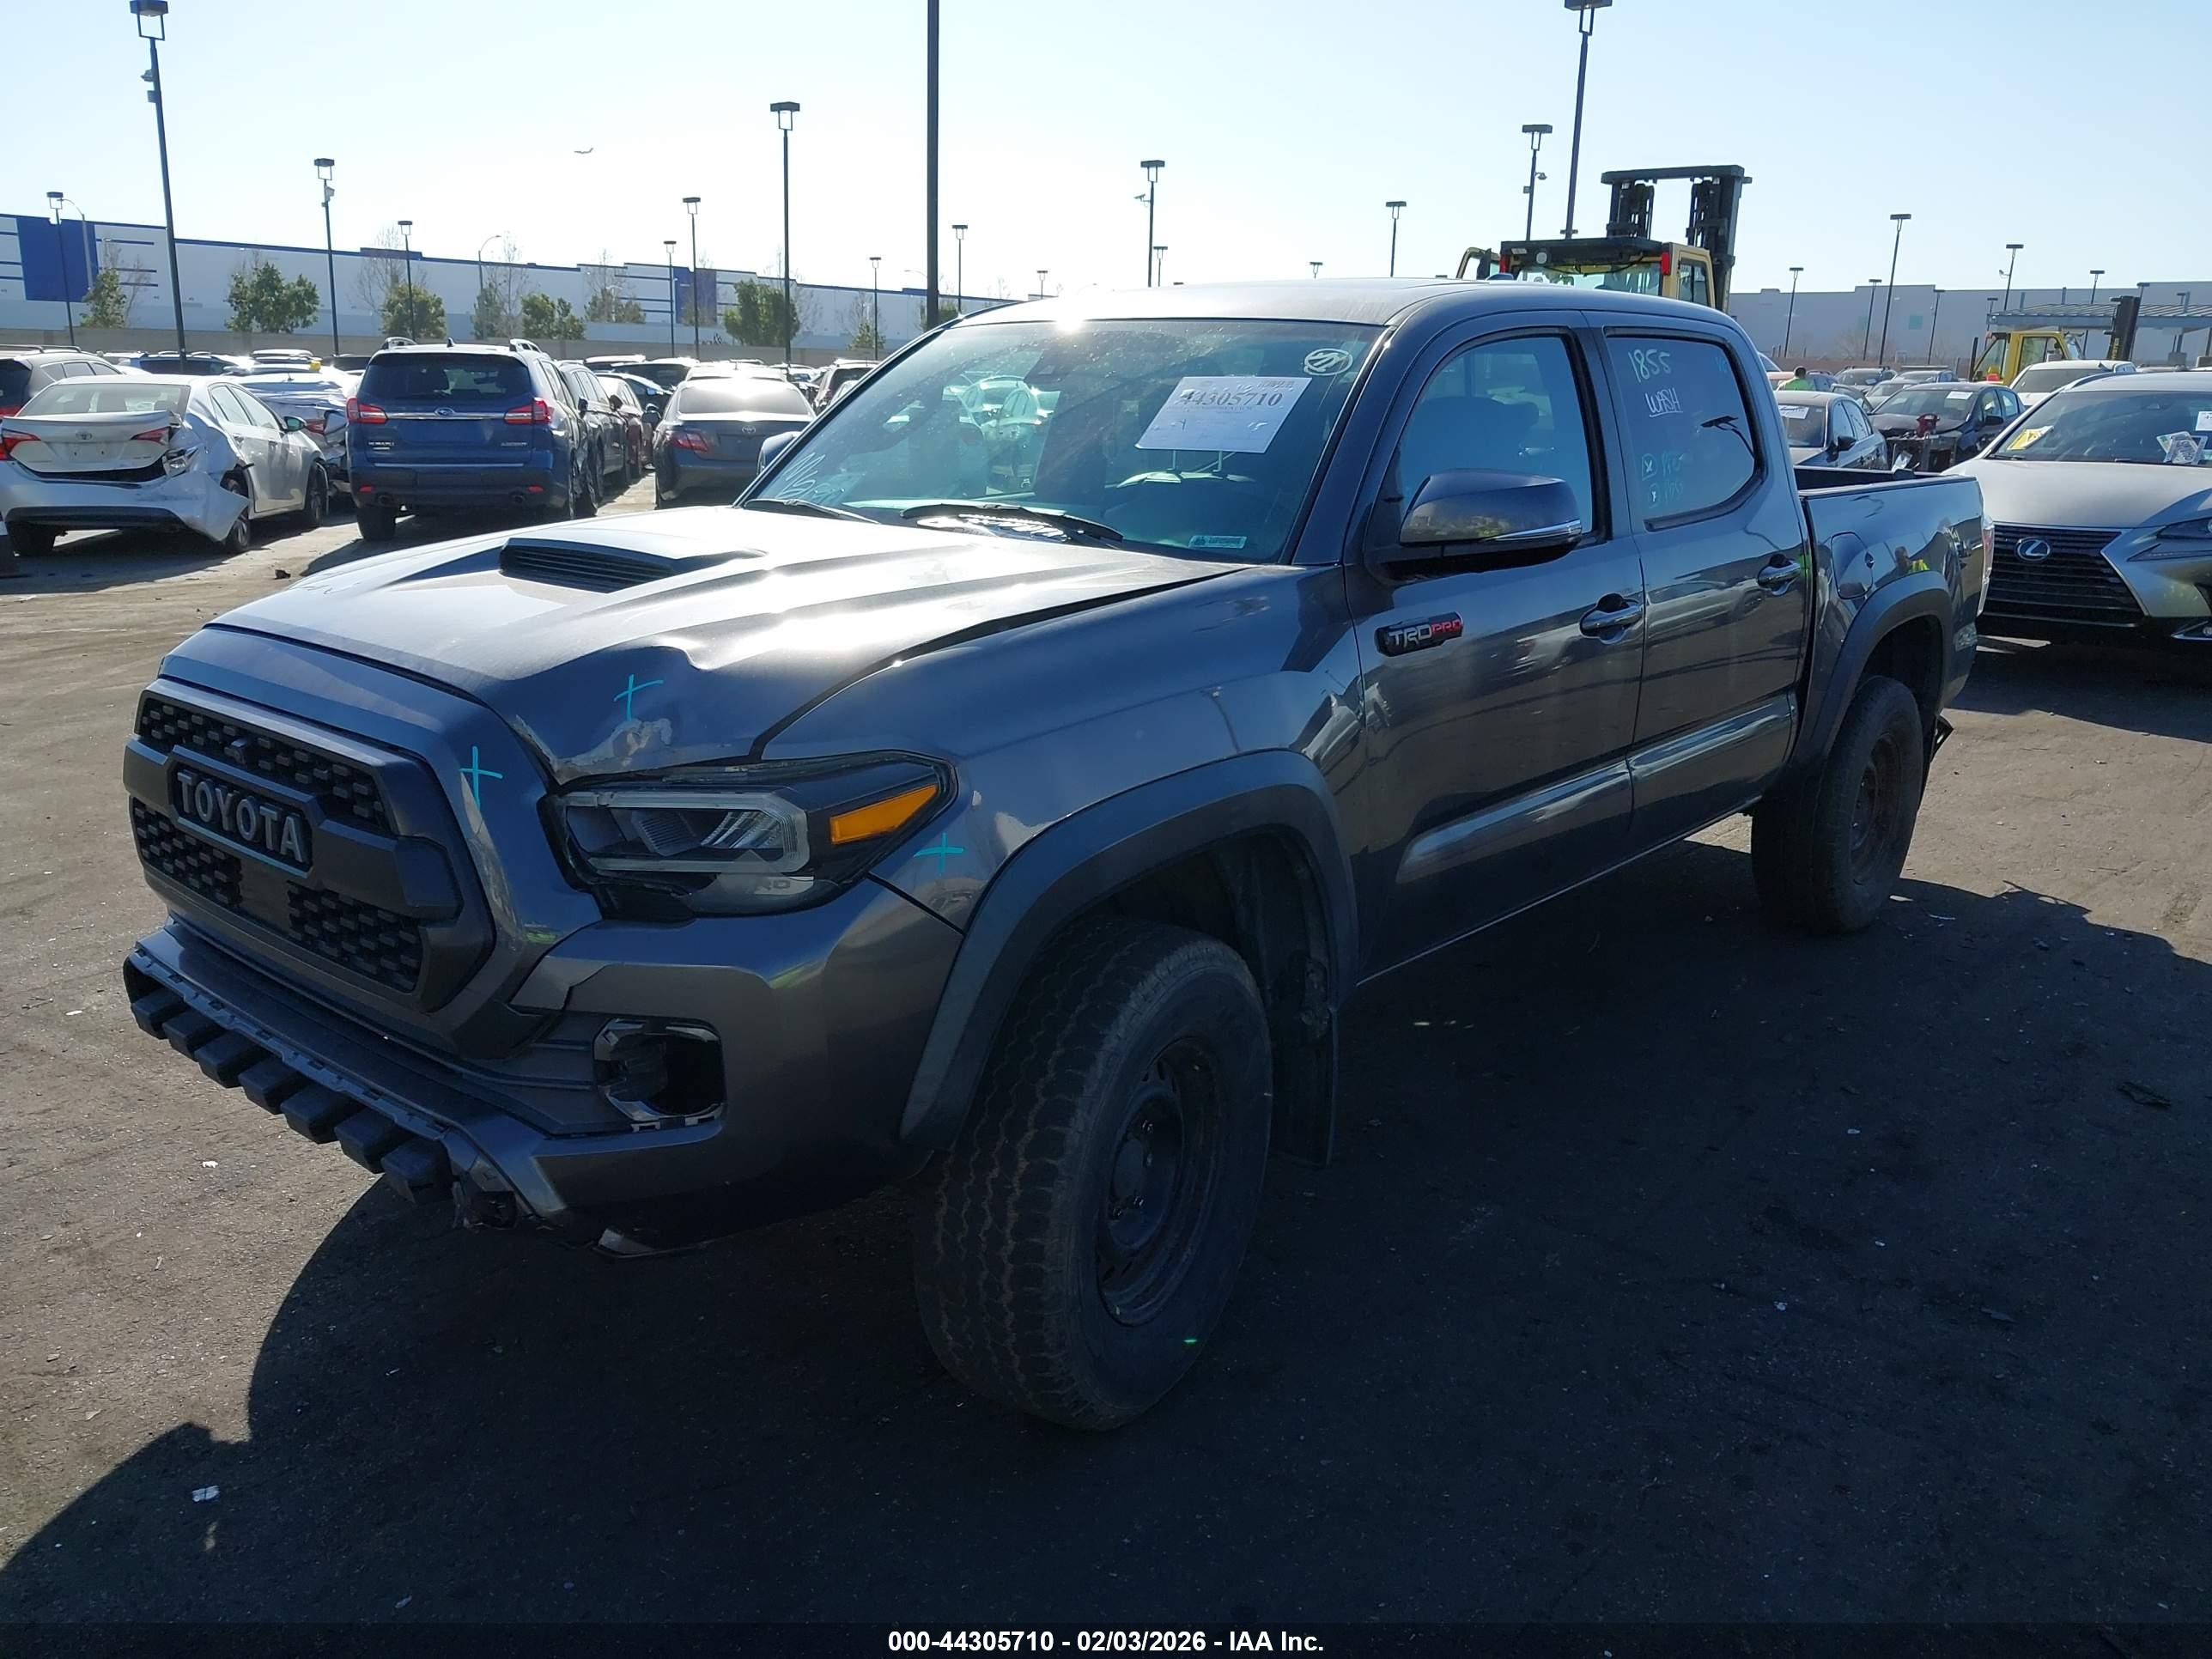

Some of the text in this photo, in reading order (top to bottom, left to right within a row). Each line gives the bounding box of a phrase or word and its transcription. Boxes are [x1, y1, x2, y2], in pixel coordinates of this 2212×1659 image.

[1627, 348, 1671, 383] 1855
[1176, 389, 1284, 407] 44305710
[1644, 386, 1682, 414] WASH
[1387, 623, 1432, 648] TRD
[177, 771, 304, 863] TOYOTA
